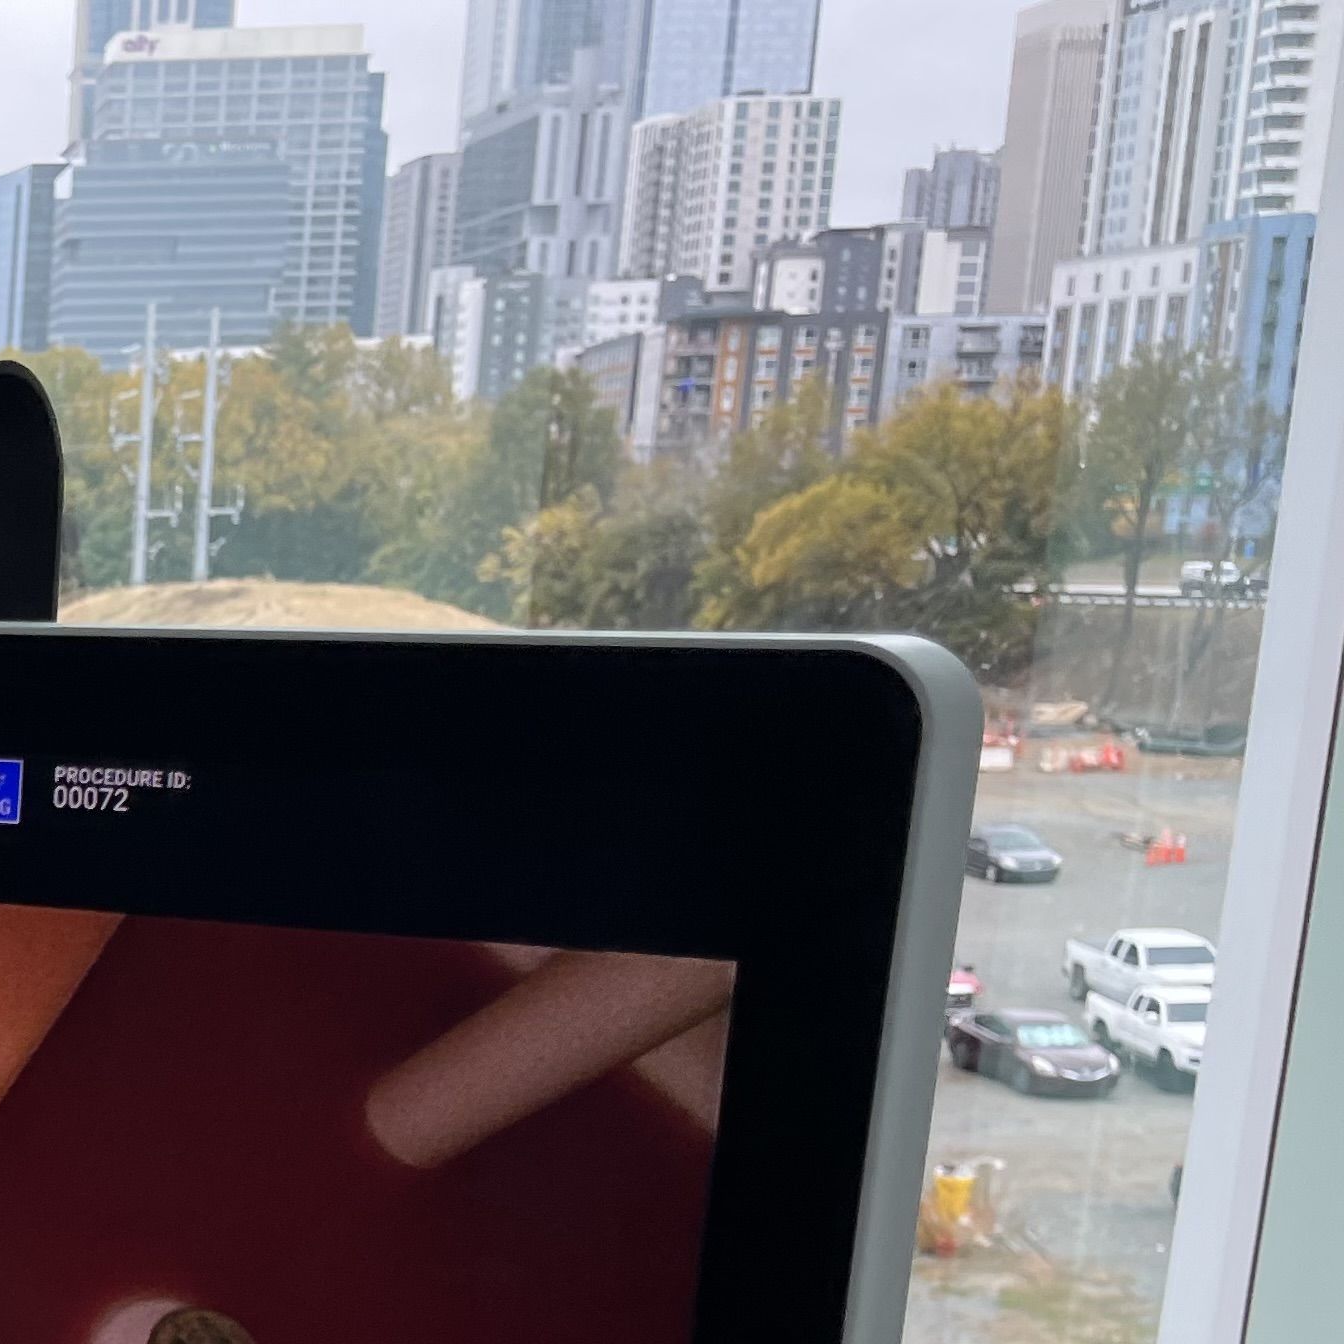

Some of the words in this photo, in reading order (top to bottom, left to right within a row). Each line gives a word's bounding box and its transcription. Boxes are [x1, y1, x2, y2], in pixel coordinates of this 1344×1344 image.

[54, 766, 164, 789] PROCEDURE
[166, 771, 192, 790] ID:
[52, 785, 130, 813] 00072
